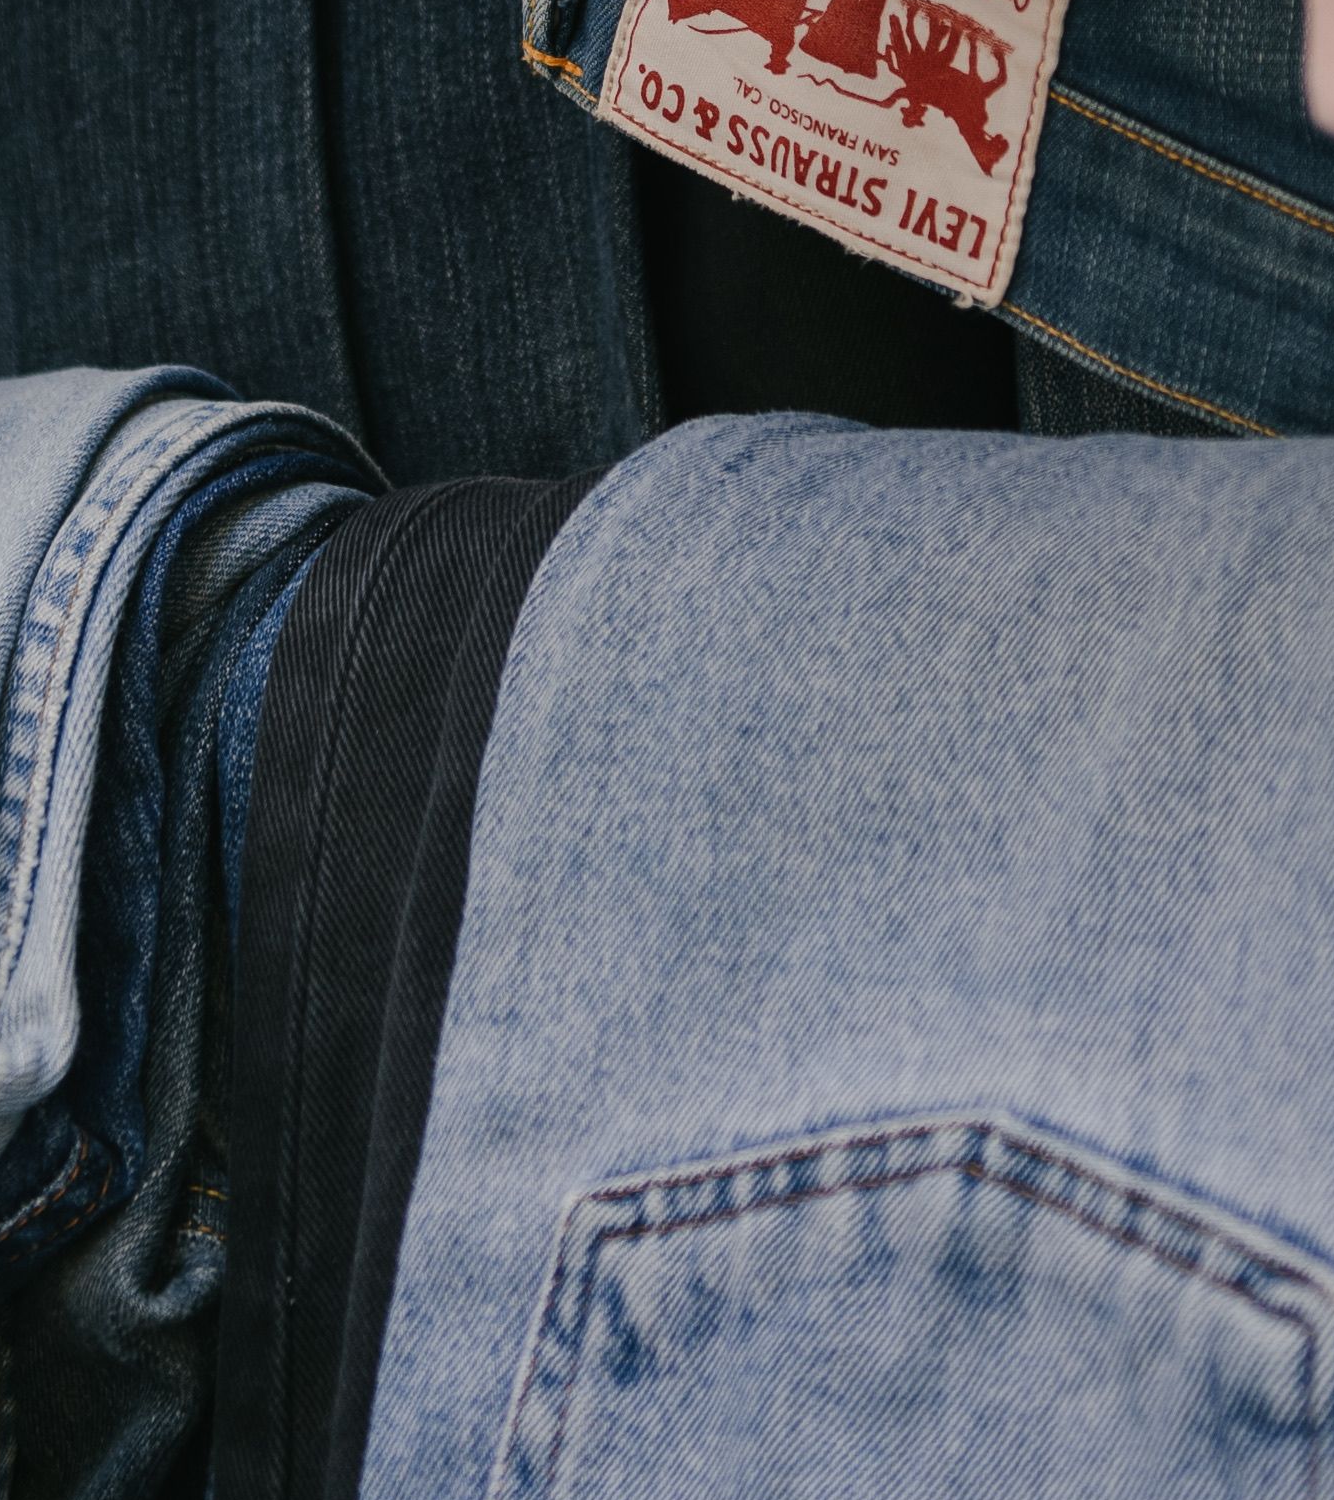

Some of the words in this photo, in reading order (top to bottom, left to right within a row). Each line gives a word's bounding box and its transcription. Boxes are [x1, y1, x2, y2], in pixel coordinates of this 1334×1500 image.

[622, 61, 694, 124] CO.
[683, 95, 723, 140] &
[725, 74, 766, 107] CAL.
[716, 108, 892, 219] STRAUSS
[859, 135, 902, 168] SAN
[891, 183, 994, 264] LEVI
